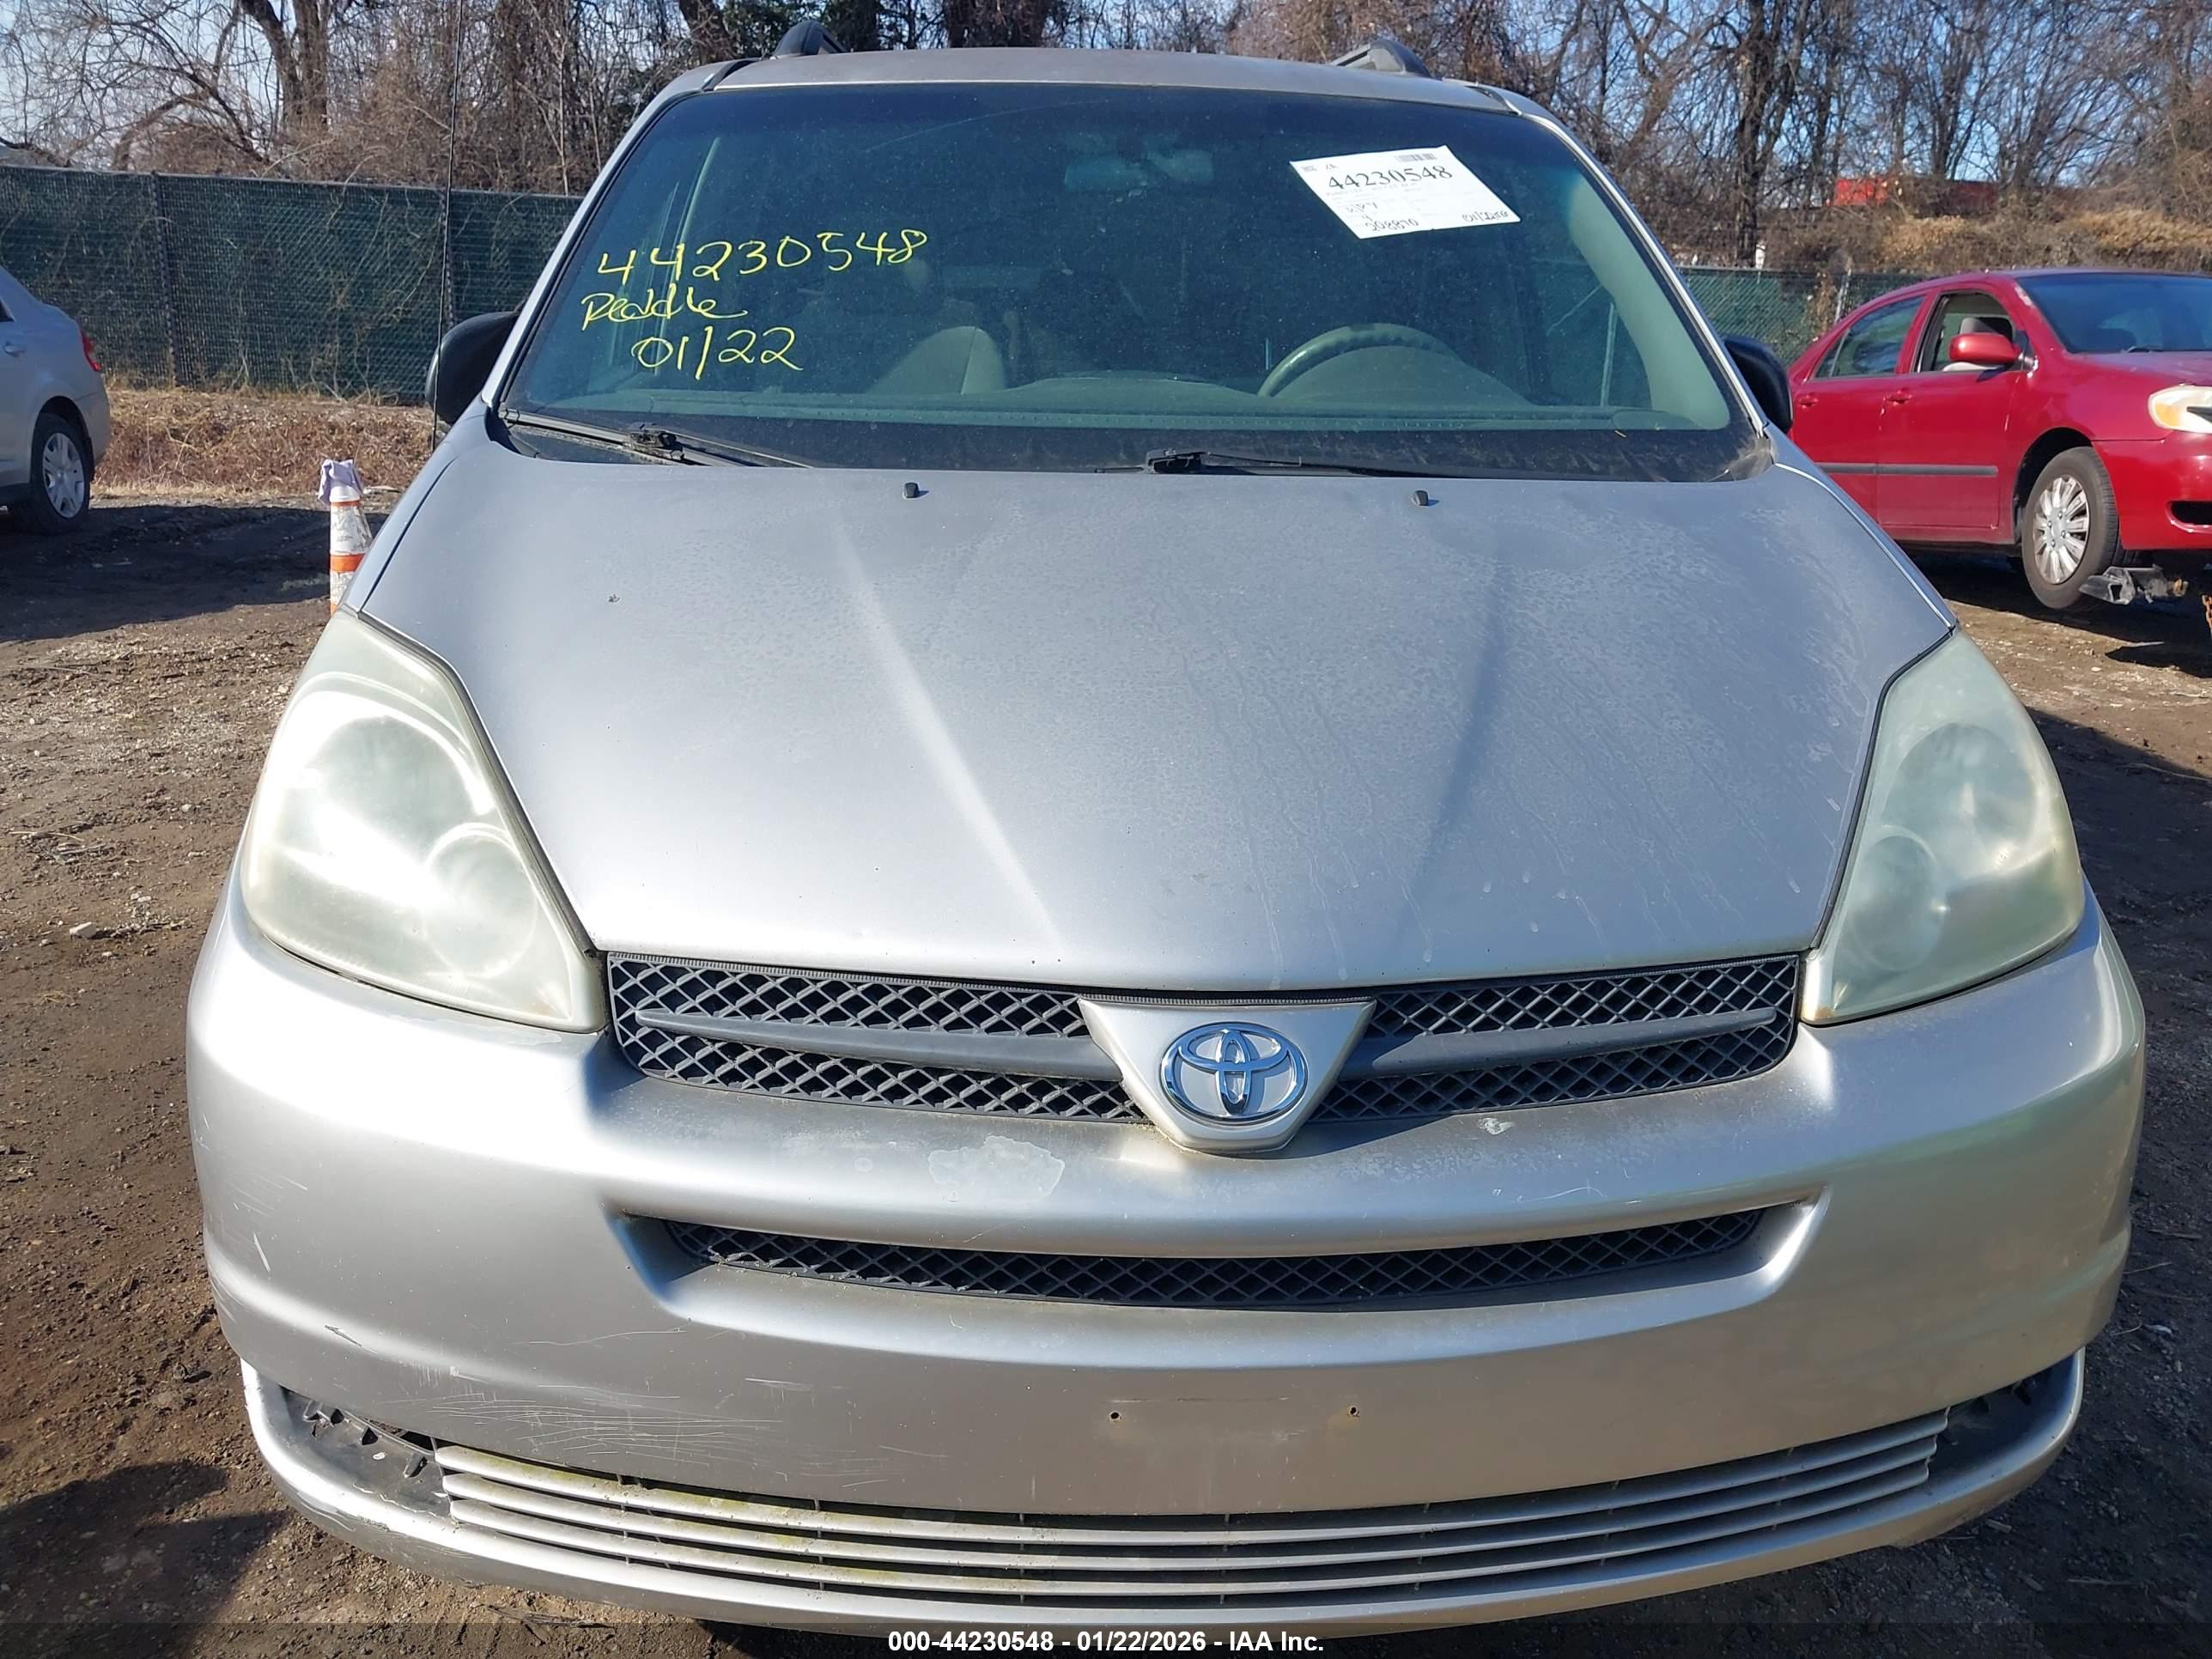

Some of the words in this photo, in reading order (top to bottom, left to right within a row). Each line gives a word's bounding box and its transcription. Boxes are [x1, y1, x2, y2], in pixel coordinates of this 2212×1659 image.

[1328, 165, 1453, 190] 44230548
[597, 229, 927, 285] 44230548
[631, 325, 804, 380] 01/22
